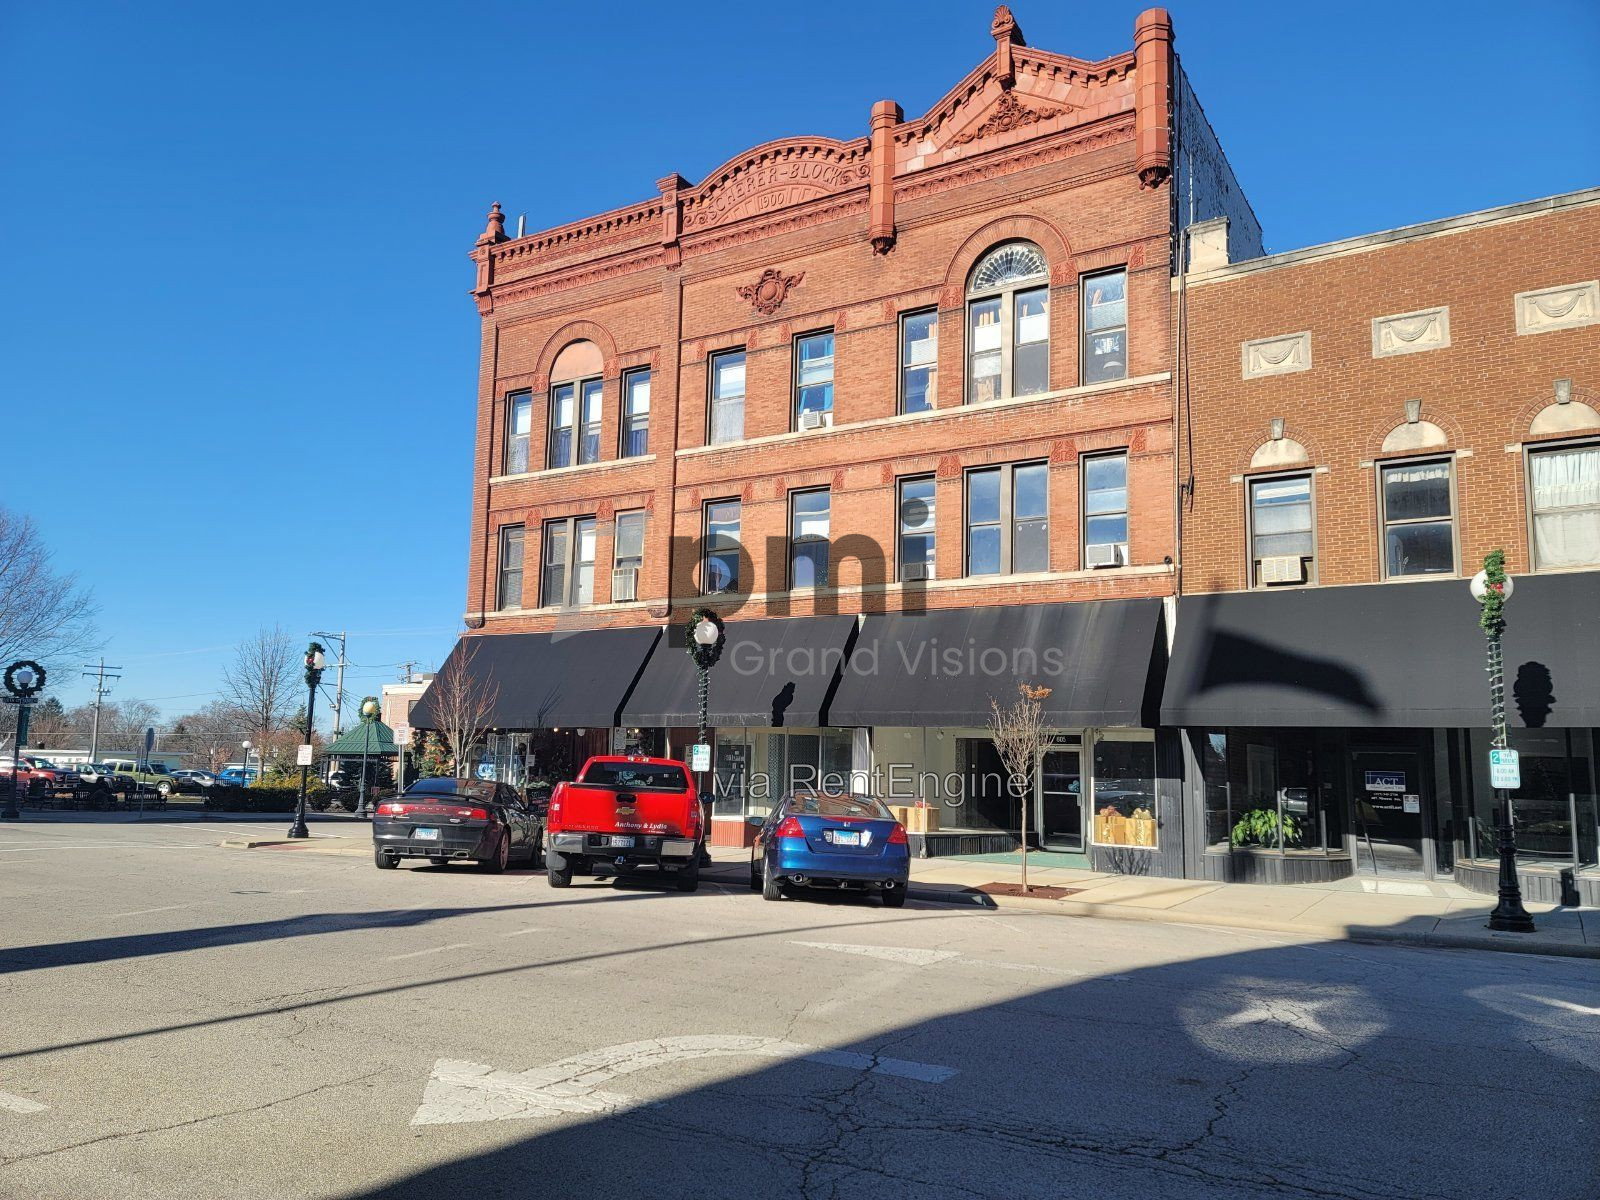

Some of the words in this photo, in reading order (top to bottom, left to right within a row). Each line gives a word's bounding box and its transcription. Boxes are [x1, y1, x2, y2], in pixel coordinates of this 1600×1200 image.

[759, 192, 785, 210] 1900
[1492, 753, 1500, 763] 2
[1374, 777, 1399, 787] ACT
[614, 821, 643, 830] Anthony
